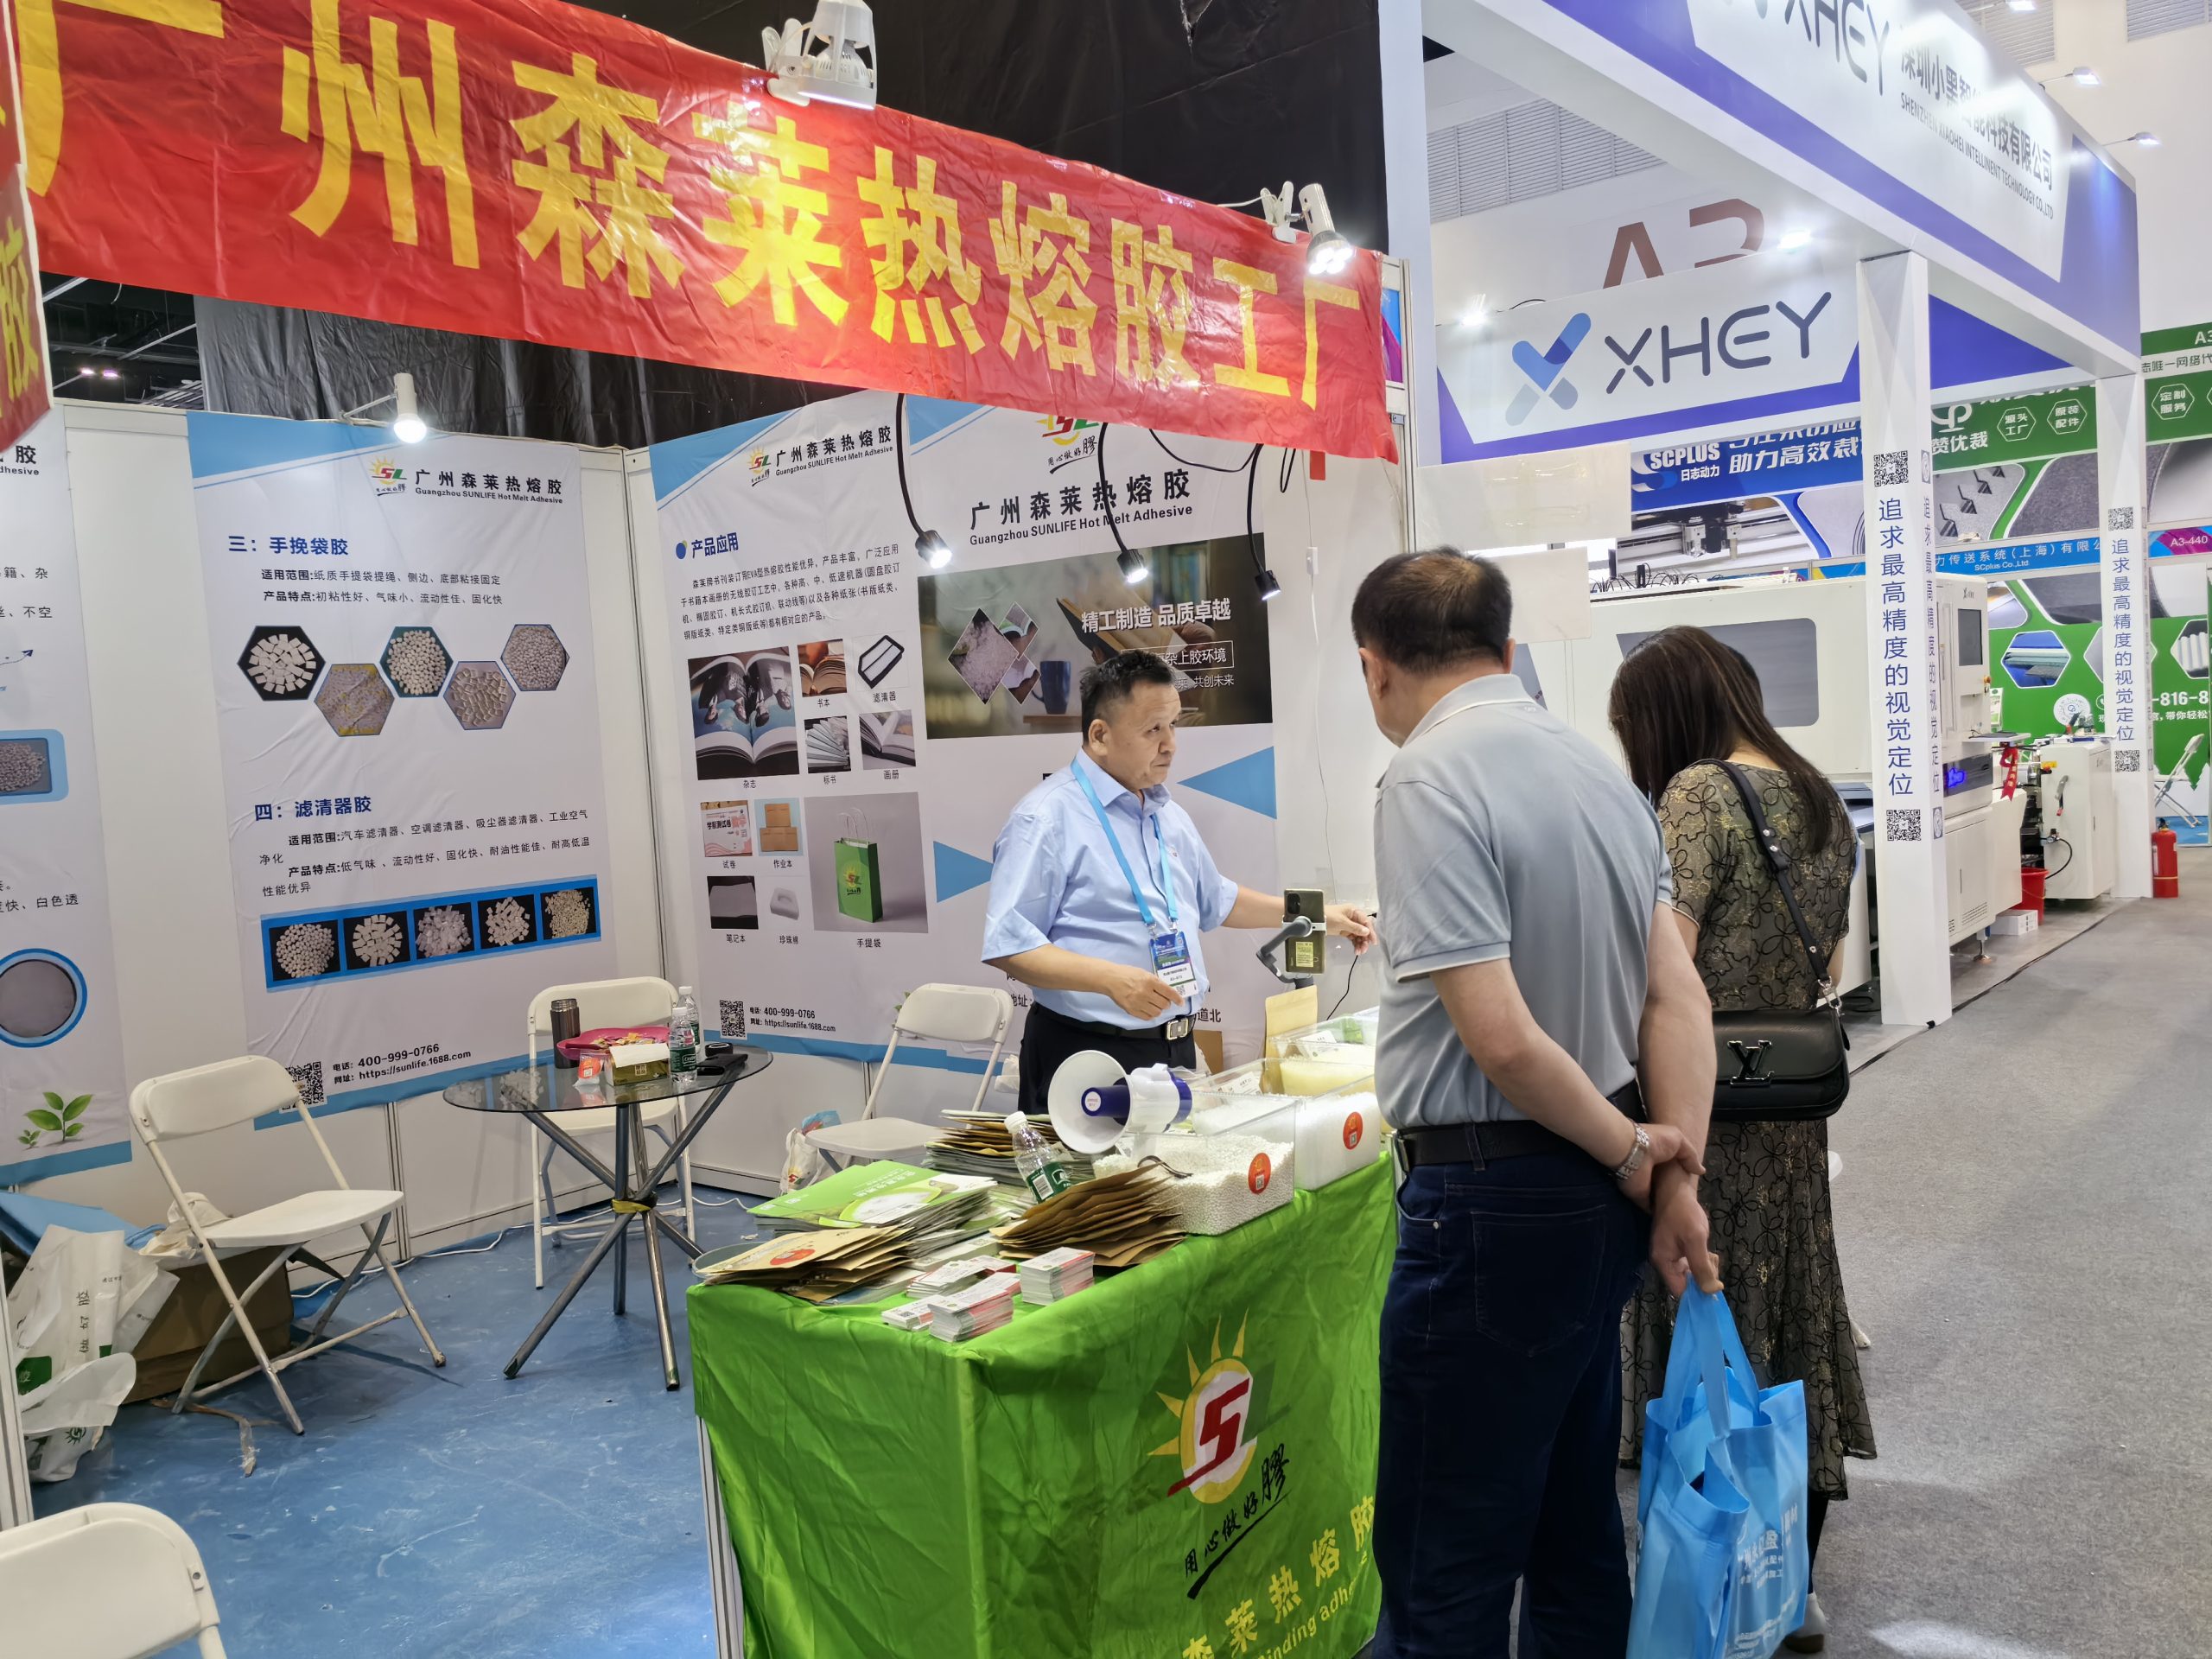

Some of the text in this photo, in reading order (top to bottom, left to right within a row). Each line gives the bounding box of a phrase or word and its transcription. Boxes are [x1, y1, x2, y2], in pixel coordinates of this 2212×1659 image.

[2001, 168, 2036, 207] TECHNOLOGY
[17, 0, 1361, 412] 广州森莱热熔胶工厂
[1605, 291, 1832, 394] XHEY
[2005, 424, 2028, 435] 工厂
[776, 426, 892, 467] 广州森莱热熔胶
[1650, 442, 1720, 470] SCPLUS
[1728, 435, 1864, 474] 助力高效裁
[776, 462, 807, 476] Guangzhou
[808, 456, 834, 469] SUNLIFE
[835, 454, 847, 463] Hot
[848, 450, 863, 461] Melt
[864, 445, 893, 458] Adhesive
[1681, 466, 1719, 481] 日志动力
[415, 468, 563, 495] 广州森莱热熔胶
[415, 486, 461, 498] Guangzhou
[462, 490, 496, 500] SUNLIFE
[498, 493, 511, 501] Hot
[512, 494, 529, 503] Melt
[530, 496, 563, 505] Adhesive
[970, 468, 1191, 530] 广州森莱热熔胶
[969, 505, 1193, 546] Guangzhou SUNLIFE Hot Melt Adhesive
[691, 532, 739, 558] 产品应用
[2170, 536, 2209, 547] A3-440
[1081, 598, 1231, 633] 精工制造 品质卓越
[1878, 497, 1914, 796] 追求最高精度的视觉定位
[2111, 538, 2135, 742] 追求最高精度的视觉定位
[1194, 674, 1235, 688] 共创未来
[254, 795, 372, 821] 四：滤清器胶
[259, 853, 283, 866] 净化
[263, 881, 311, 898] 性能优异
[856, 938, 881, 949] 手提袋
[764, 1007, 816, 1020] 400-999-0766
[1198, 1007, 1221, 1023] 道北
[358, 1042, 440, 1068] 400-999-0766
[359, 1050, 472, 1080] https://sunlife.1688.com
[1259, 1614, 1317, 1659] inding
